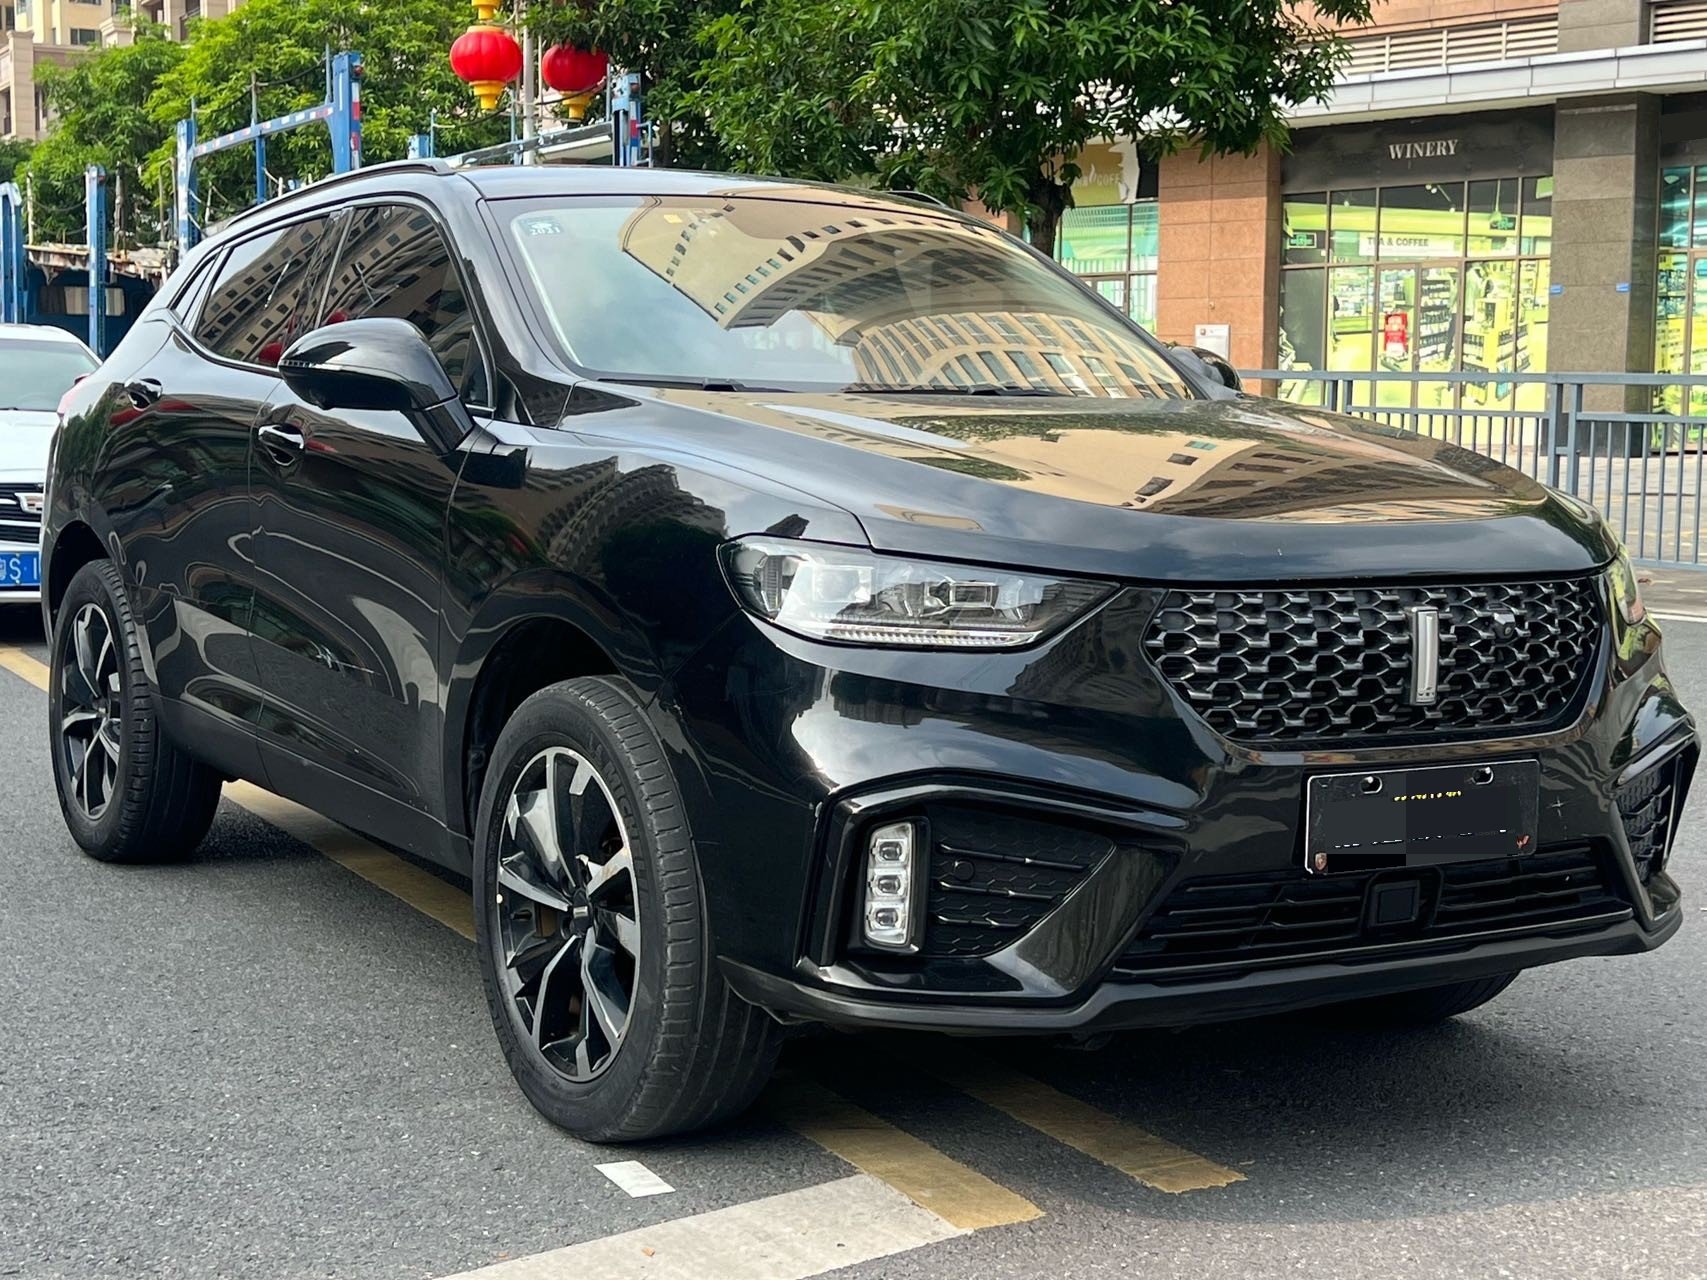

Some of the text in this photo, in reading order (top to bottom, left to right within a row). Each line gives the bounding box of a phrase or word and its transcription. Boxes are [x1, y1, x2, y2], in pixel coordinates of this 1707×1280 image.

[1389, 139, 1458, 159] WINERY
[1367, 237, 1385, 247] TA
[1396, 237, 1429, 247] COFFEE
